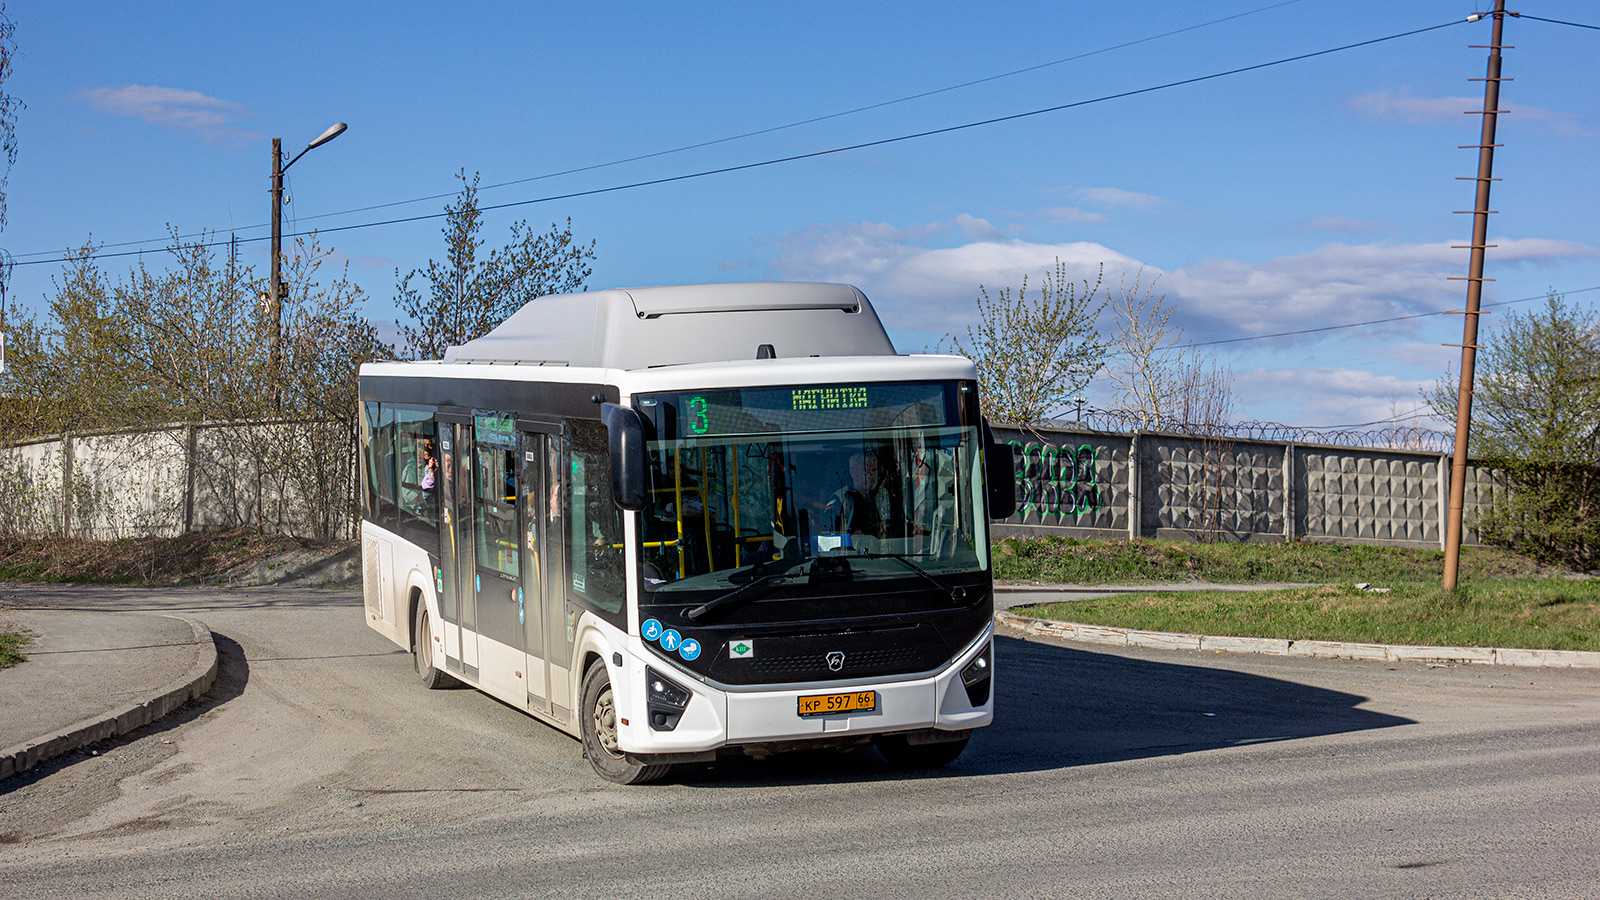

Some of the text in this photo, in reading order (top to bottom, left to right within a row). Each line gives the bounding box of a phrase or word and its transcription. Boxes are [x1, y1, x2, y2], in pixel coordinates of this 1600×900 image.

[792, 387, 868, 410] МАГНИТКА
[689, 396, 709, 434] 3
[805, 695, 851, 711] КР 597
[857, 693, 870, 703] 66
